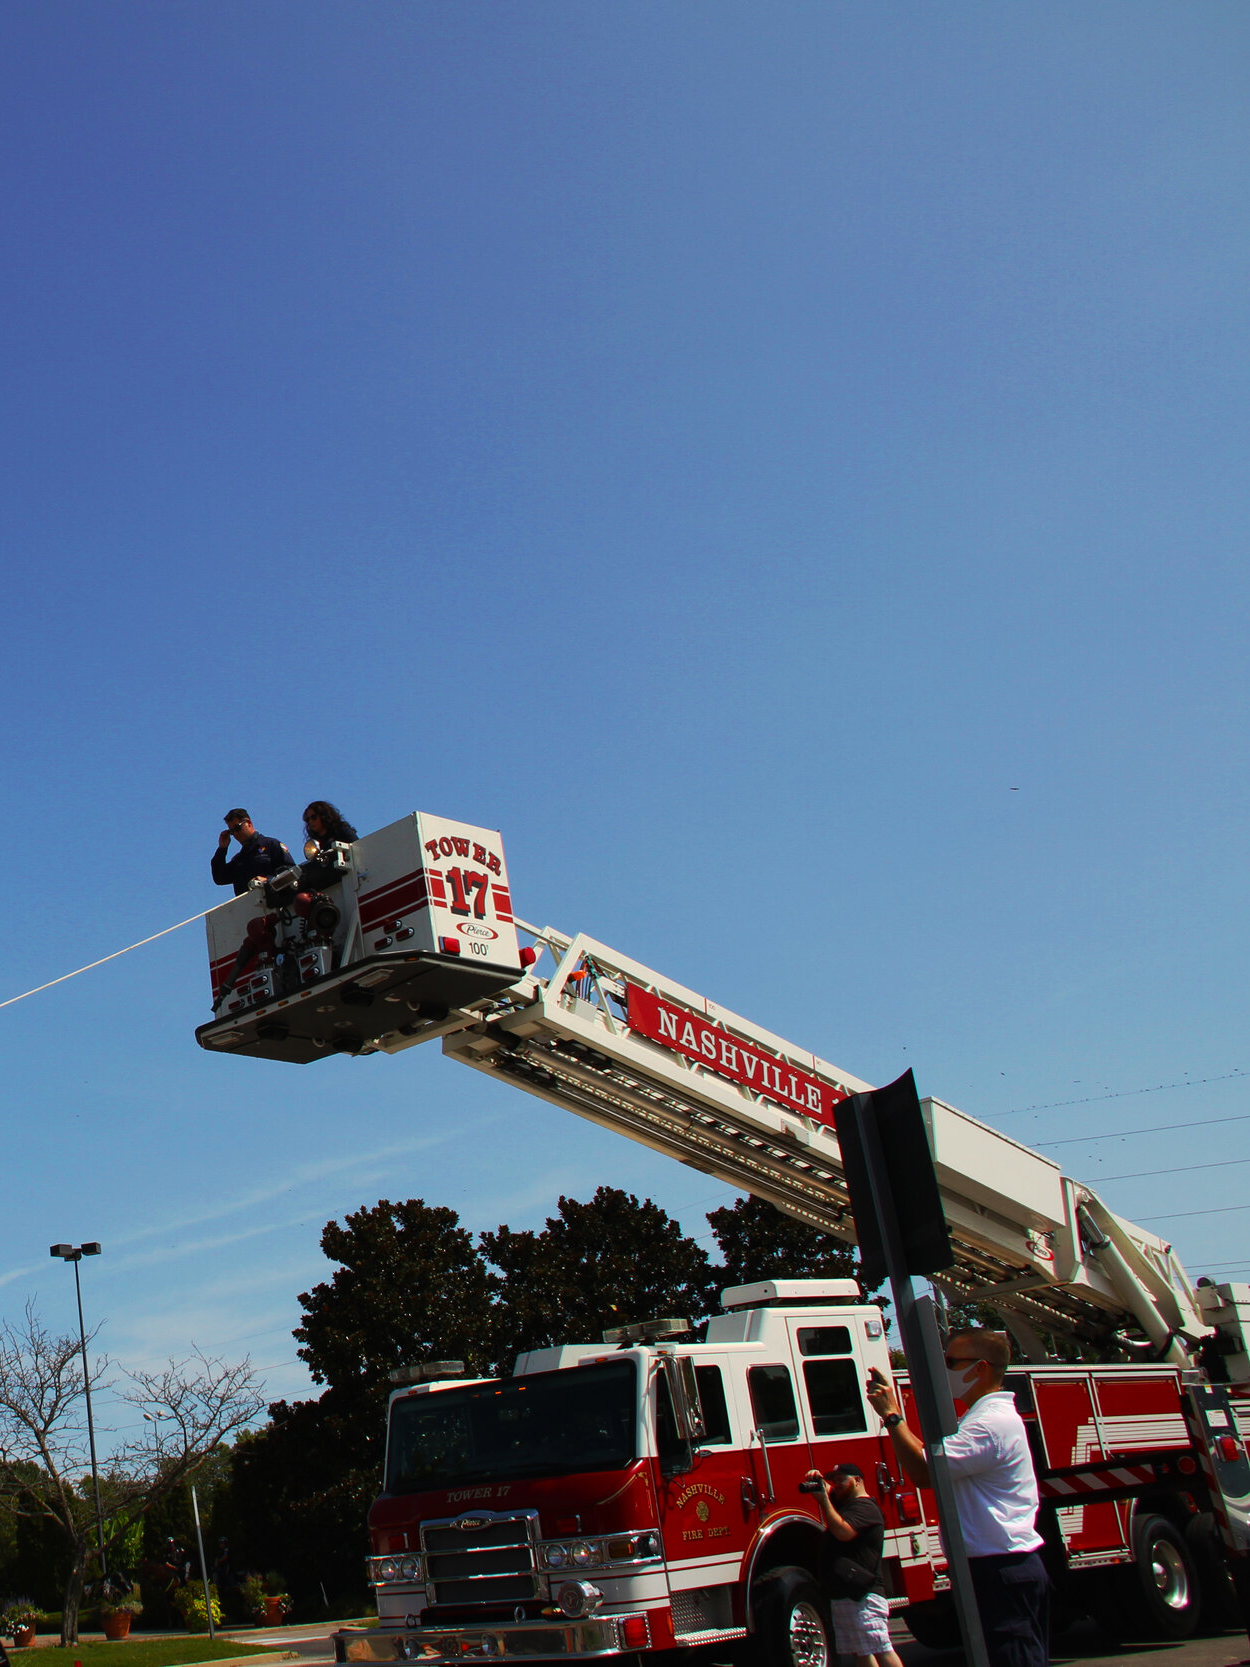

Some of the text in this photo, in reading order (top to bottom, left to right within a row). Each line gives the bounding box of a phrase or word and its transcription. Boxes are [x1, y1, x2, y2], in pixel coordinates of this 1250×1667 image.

[424, 835, 501, 877] TOWER
[445, 866, 488, 920] 17
[466, 924, 490, 937] Pierce
[657, 1006, 823, 1114] NASHVILLE
[446, 1485, 512, 1503] TOWER 17
[676, 1483, 726, 1508] NASHVILLE
[682, 1529, 704, 1541] FIRE
